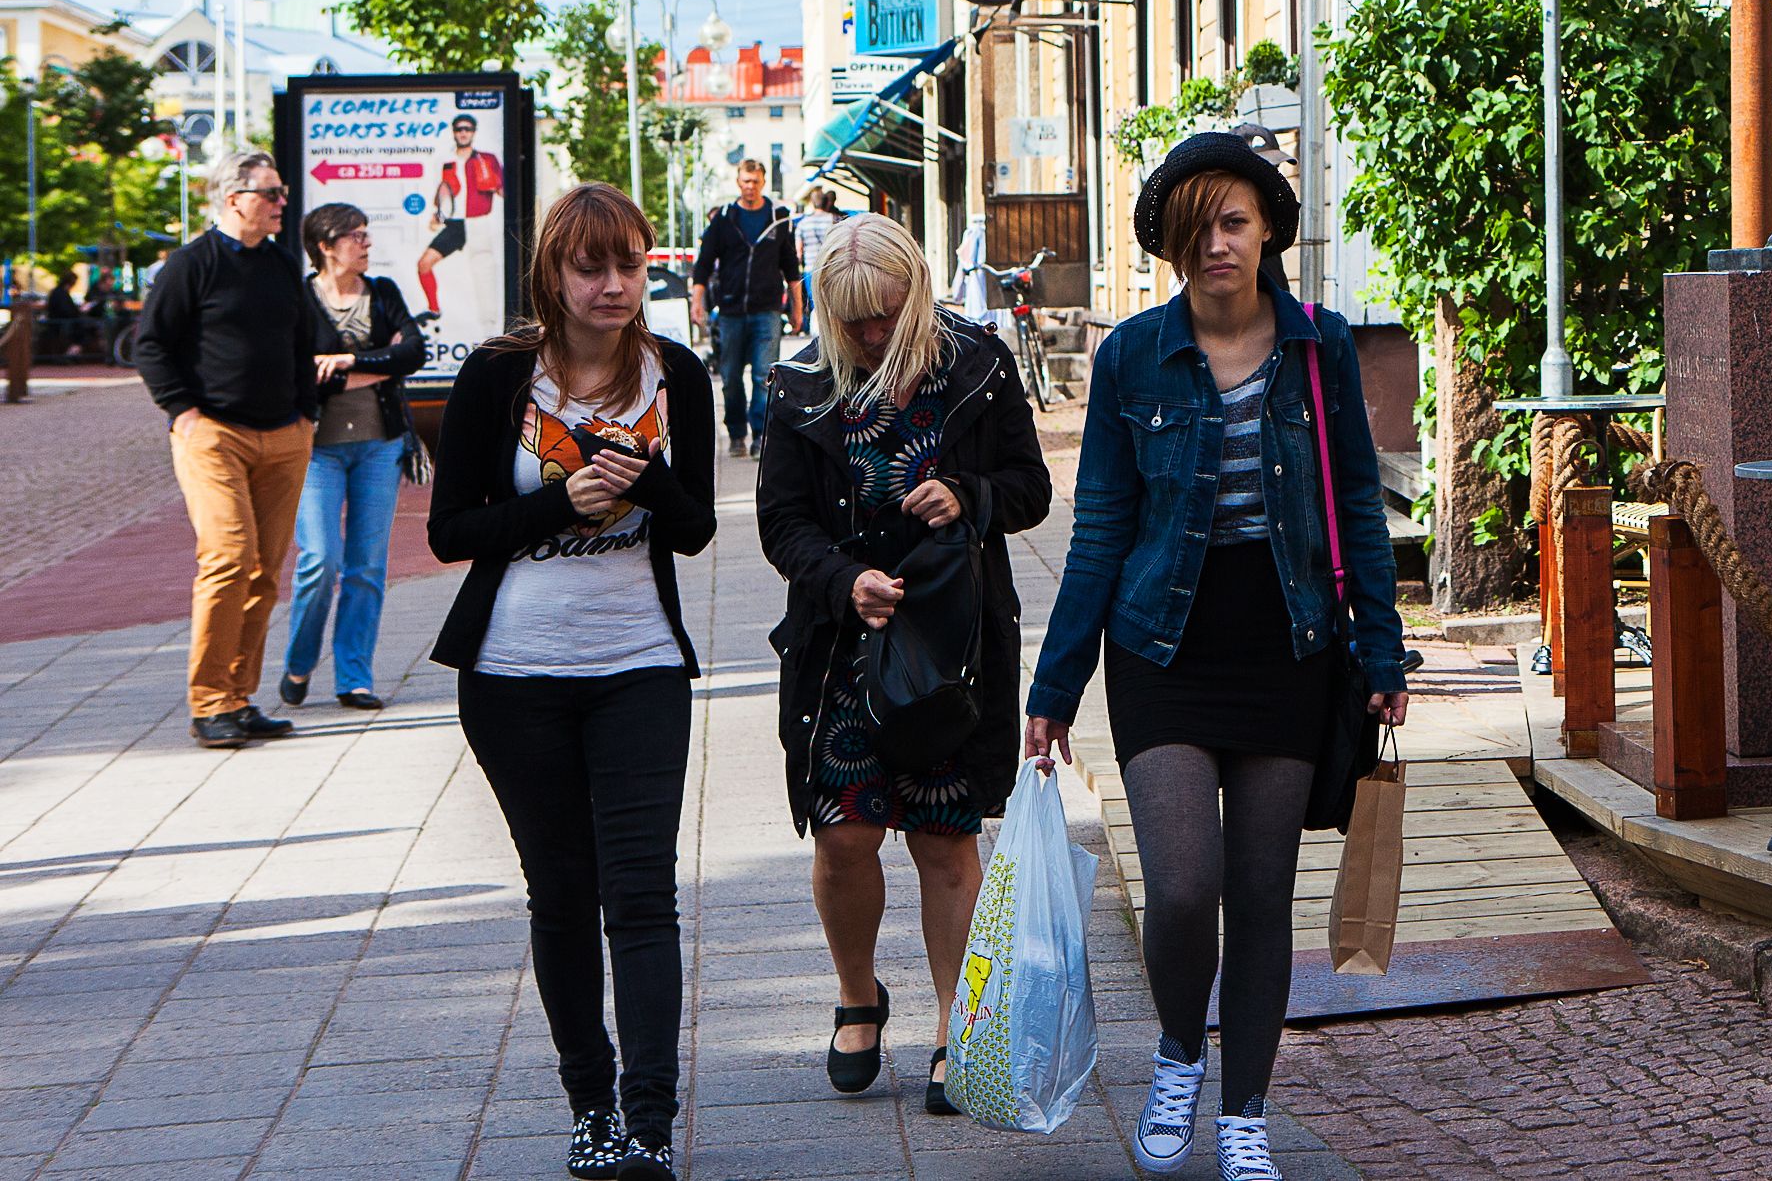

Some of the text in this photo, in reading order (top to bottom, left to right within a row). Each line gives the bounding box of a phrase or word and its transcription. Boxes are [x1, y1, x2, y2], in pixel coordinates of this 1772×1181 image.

[850, 63, 905, 72] OPTIKER
[308, 97, 440, 115] A COMPLETE
[309, 121, 449, 140] SPORTS SHOP
[310, 146, 334, 155] with
[338, 145, 374, 156] bicycle
[337, 166, 355, 178] ca
[423, 343, 479, 362] SPO
